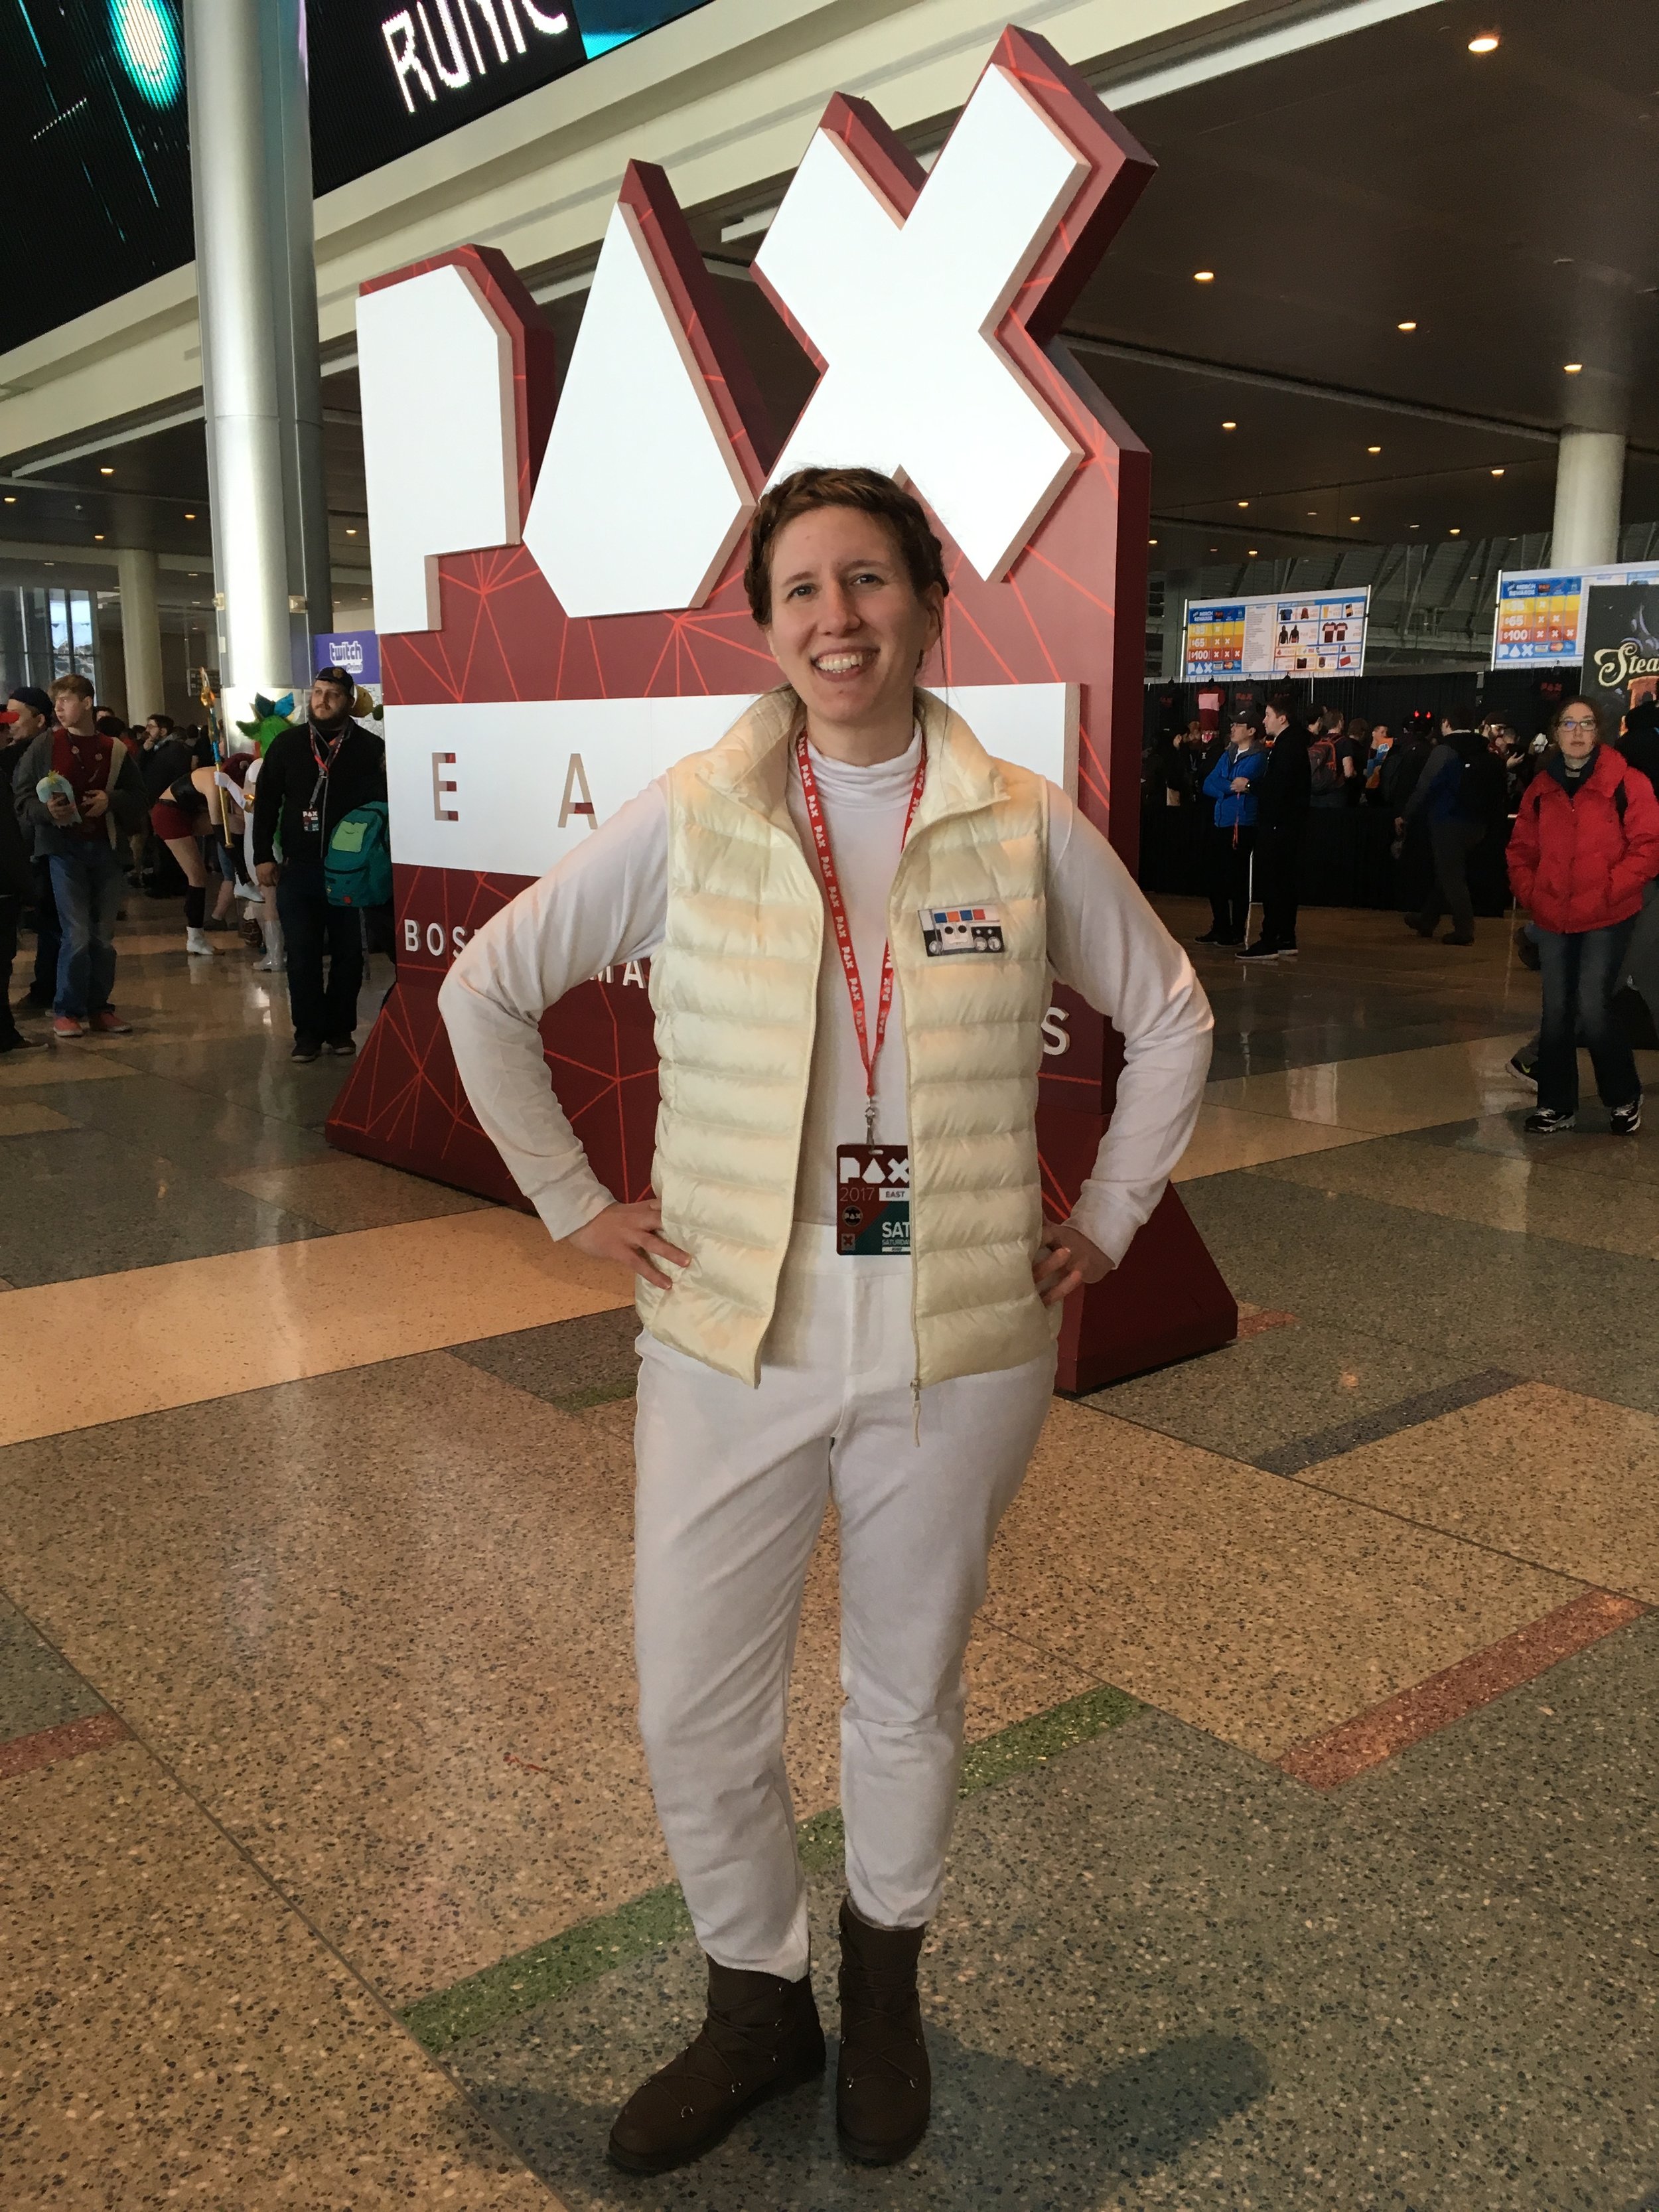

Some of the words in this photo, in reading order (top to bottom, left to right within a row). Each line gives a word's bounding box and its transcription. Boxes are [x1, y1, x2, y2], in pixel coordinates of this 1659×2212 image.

[356, 62, 1093, 635] PAX
[1504, 615, 1524, 627] $65
[1504, 629, 1528, 641] $100
[1192, 638, 1205, 648] $65
[1498, 643, 1534, 658] PAX
[329, 640, 363, 664] twitch
[1191, 650, 1208, 660] $100
[346, 663, 363, 674] Prime
[1188, 662, 1213, 675] PAX
[801, 764, 812, 788] PAX
[807, 794, 819, 818] PAX
[814, 825, 826, 848] PAX
[821, 855, 833, 878] PAX
[828, 886, 840, 908] PAX
[835, 915, 847, 938] PAX
[841, 946, 855, 969] PAX
[849, 977, 861, 1001] PAX
[882, 978, 892, 1001] PAX
[839, 1157, 910, 1184] PAX
[839, 1187, 875, 1202] 2017
[882, 1221, 910, 1238] SAT
